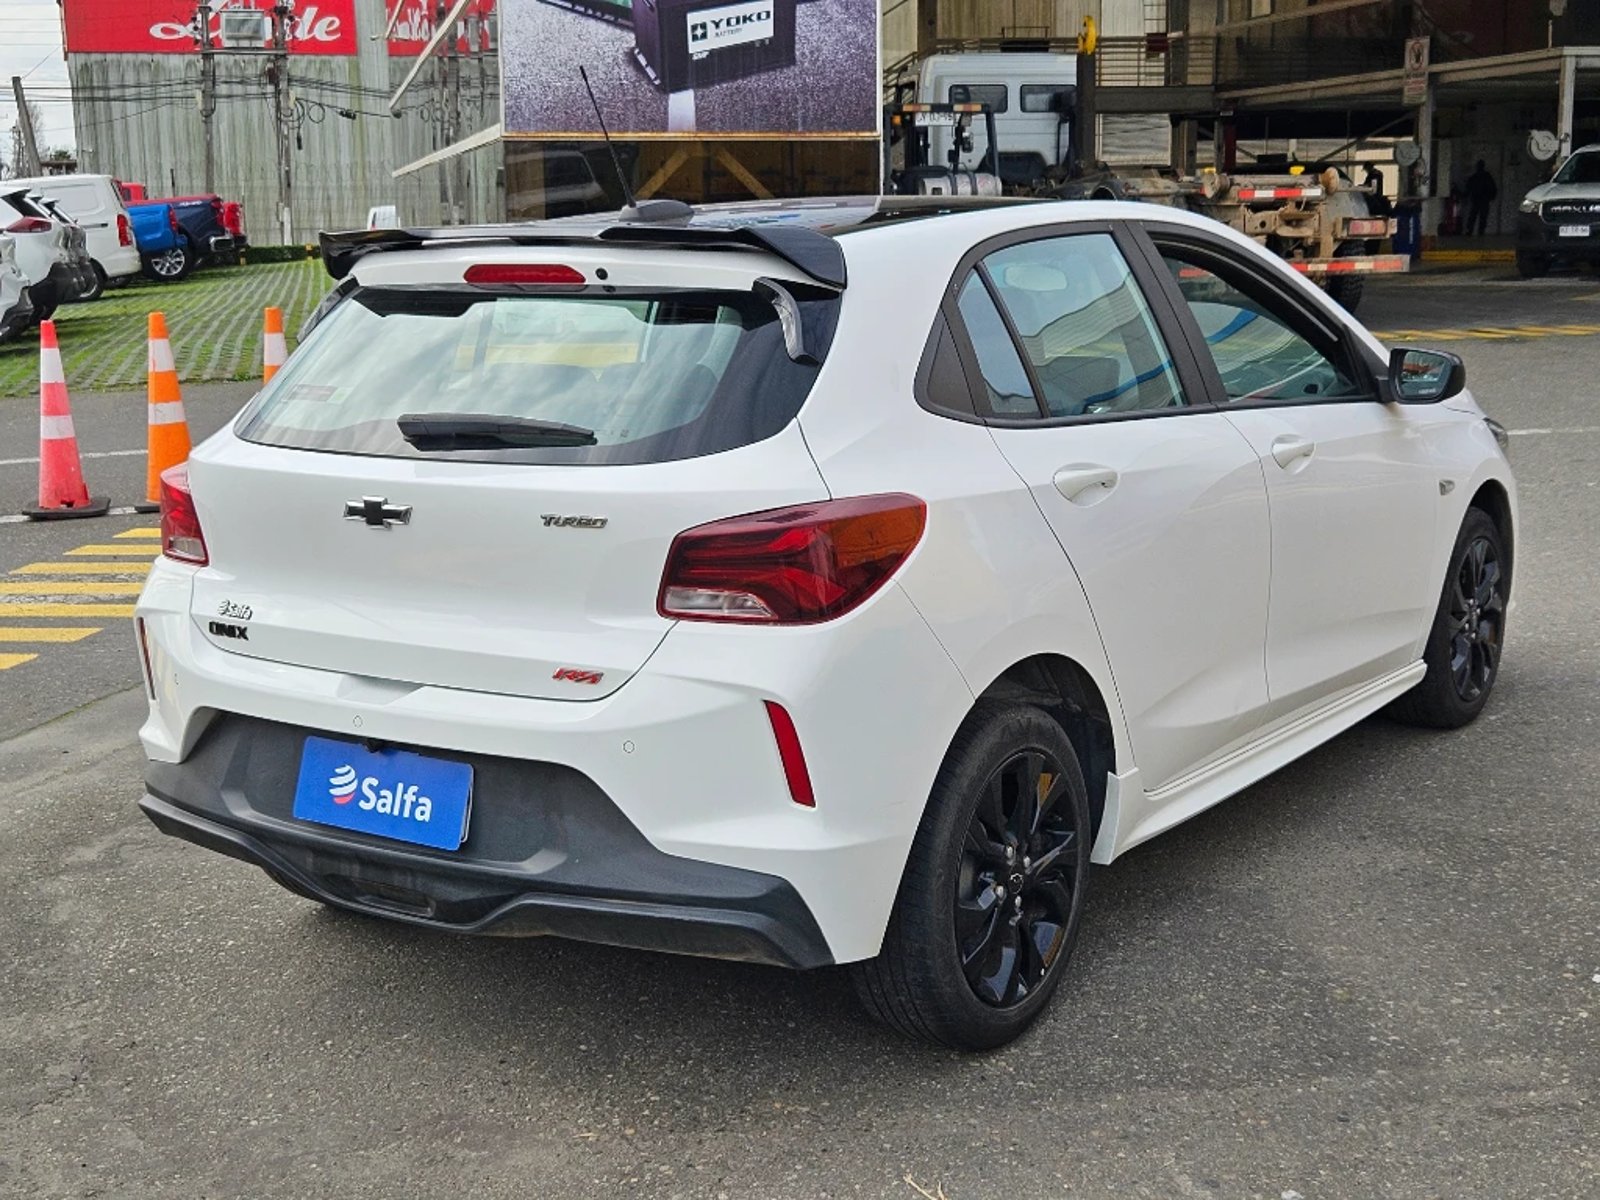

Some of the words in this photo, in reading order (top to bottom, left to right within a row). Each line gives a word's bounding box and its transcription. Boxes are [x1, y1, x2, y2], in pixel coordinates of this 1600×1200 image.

[149, 0, 342, 42] Lde
[710, 10, 771, 30] YOKO
[540, 513, 608, 529] TURBO
[209, 621, 249, 641] ONIX
[552, 667, 604, 685] RS
[358, 776, 433, 823] Salfa
